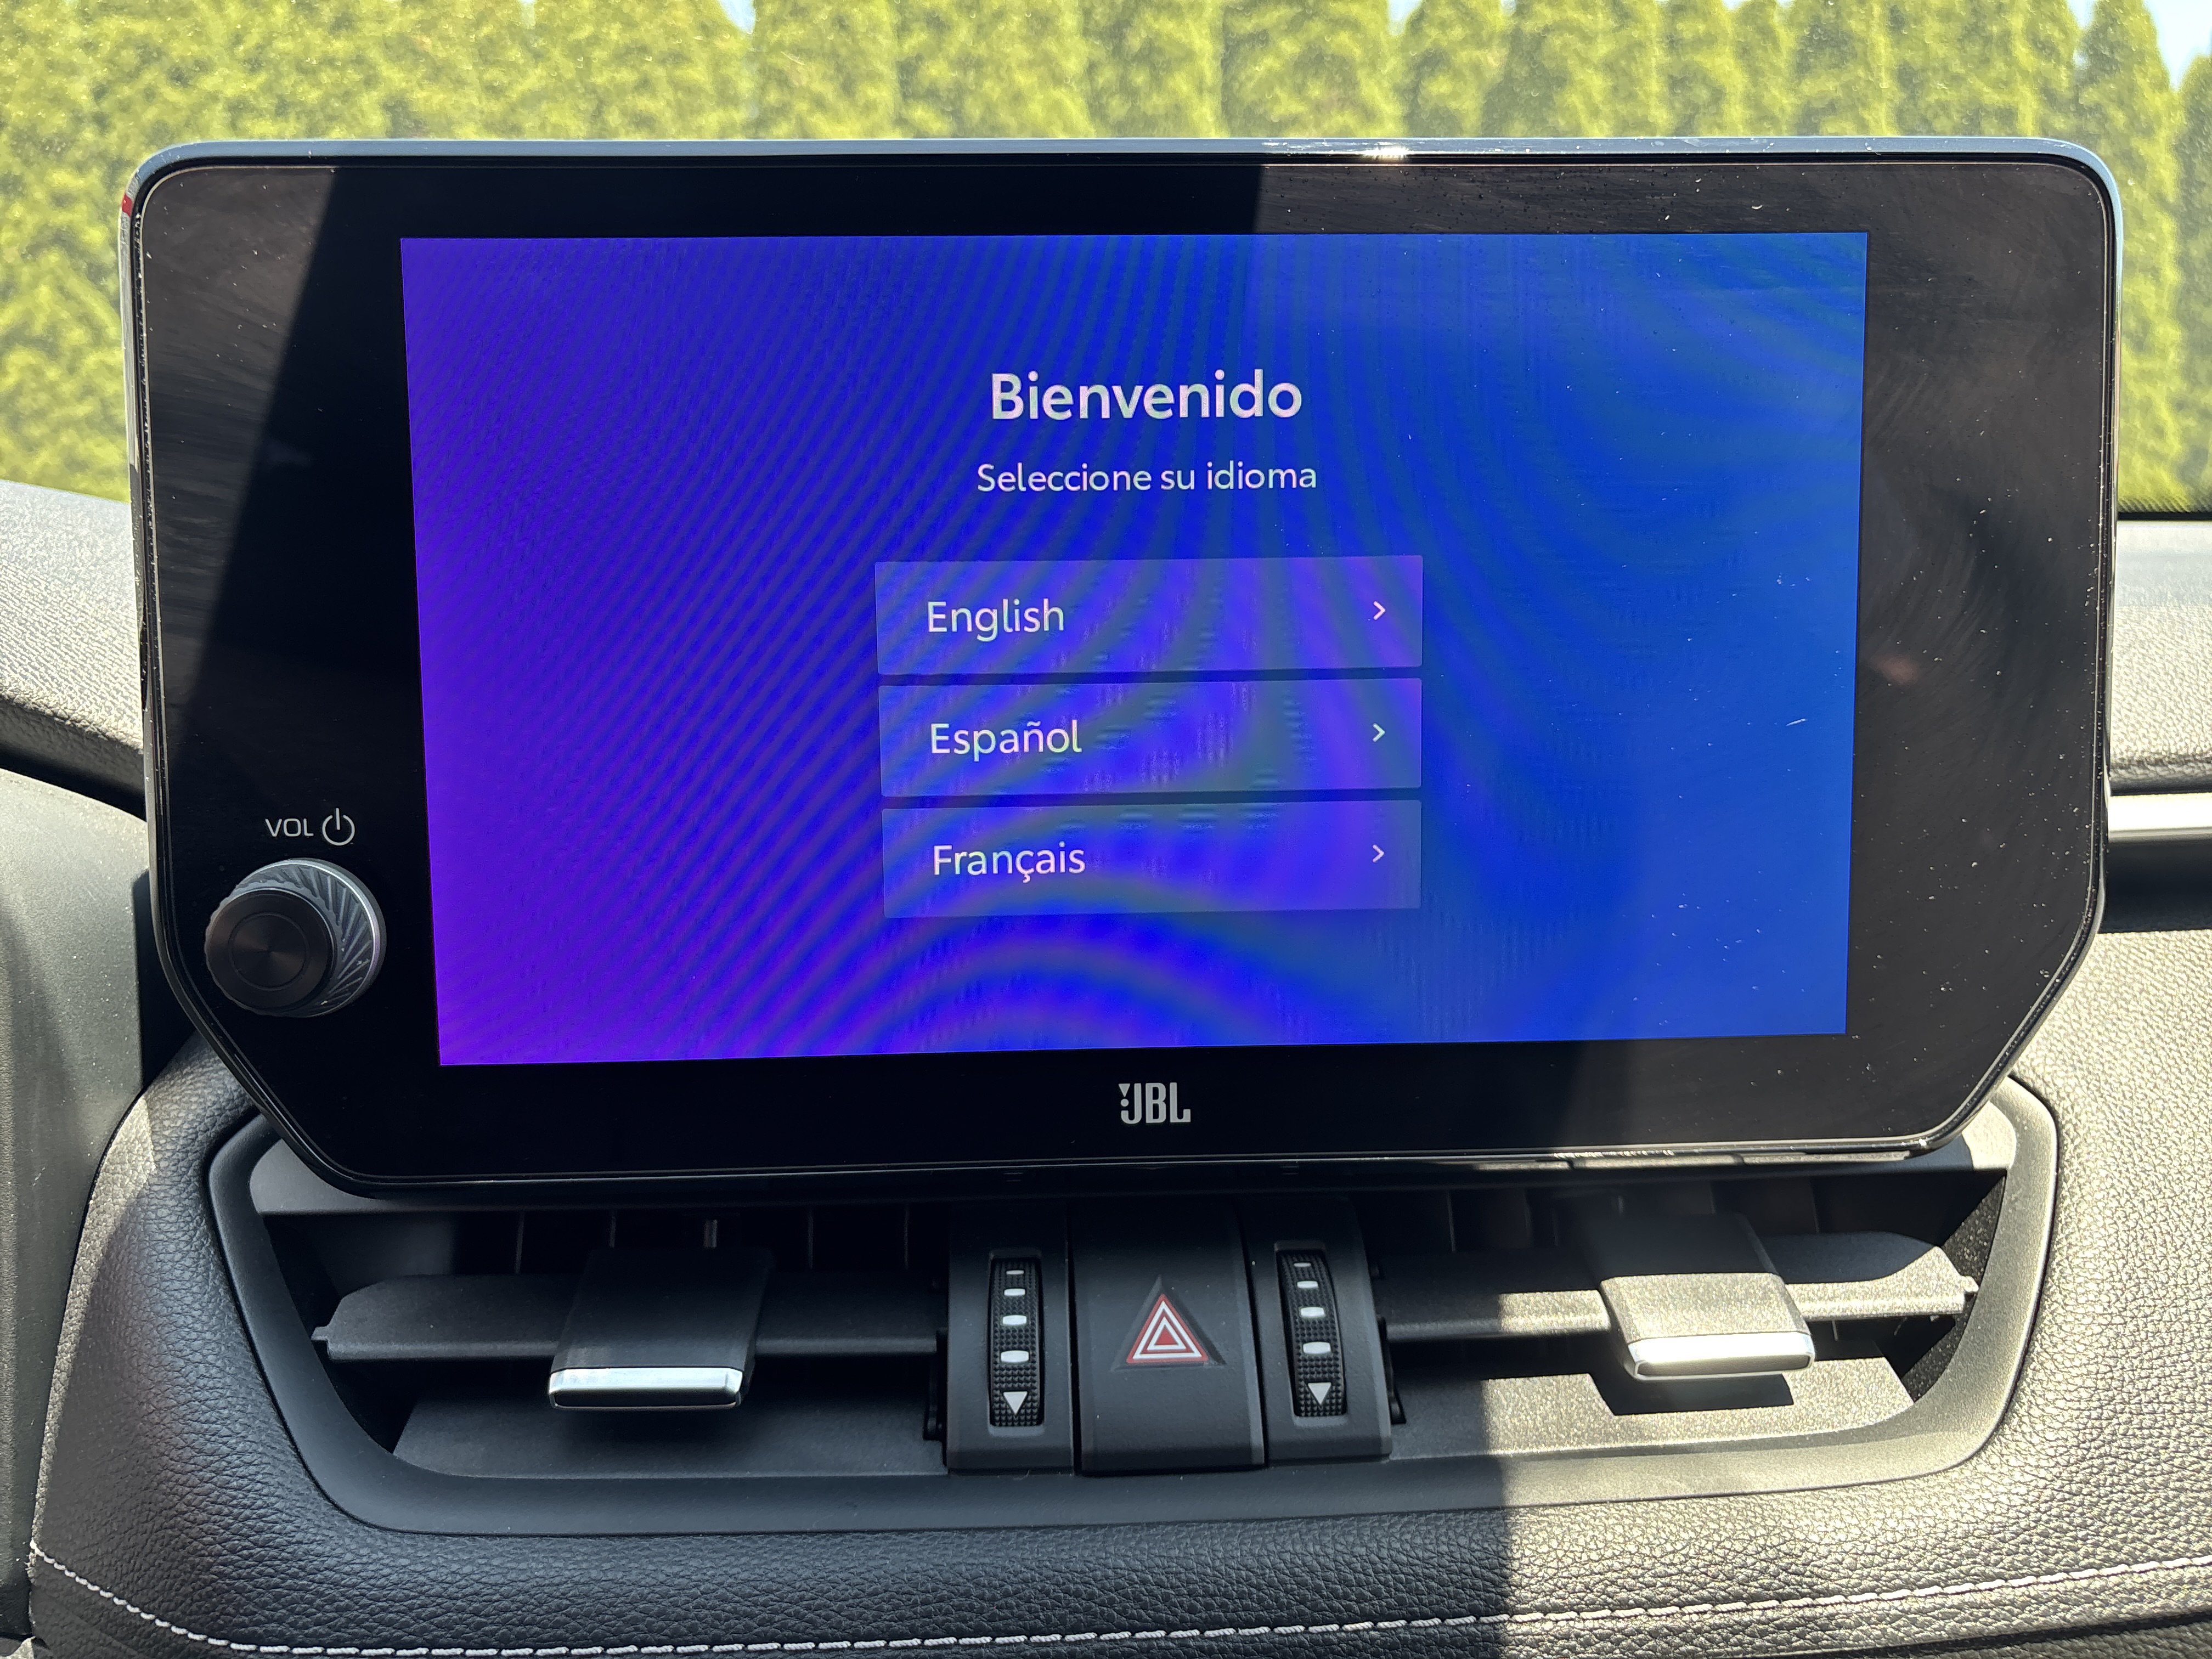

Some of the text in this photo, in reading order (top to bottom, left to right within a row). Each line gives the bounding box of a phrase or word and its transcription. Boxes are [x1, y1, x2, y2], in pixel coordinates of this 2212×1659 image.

[991, 369, 1303, 421] Bienvenido
[977, 461, 1317, 493] Seleccione su idioma
[927, 599, 1065, 641] English
[930, 720, 1081, 761] Español
[264, 818, 314, 837] VOL
[933, 842, 1086, 883] Français
[1118, 1082, 1191, 1124] JBL
